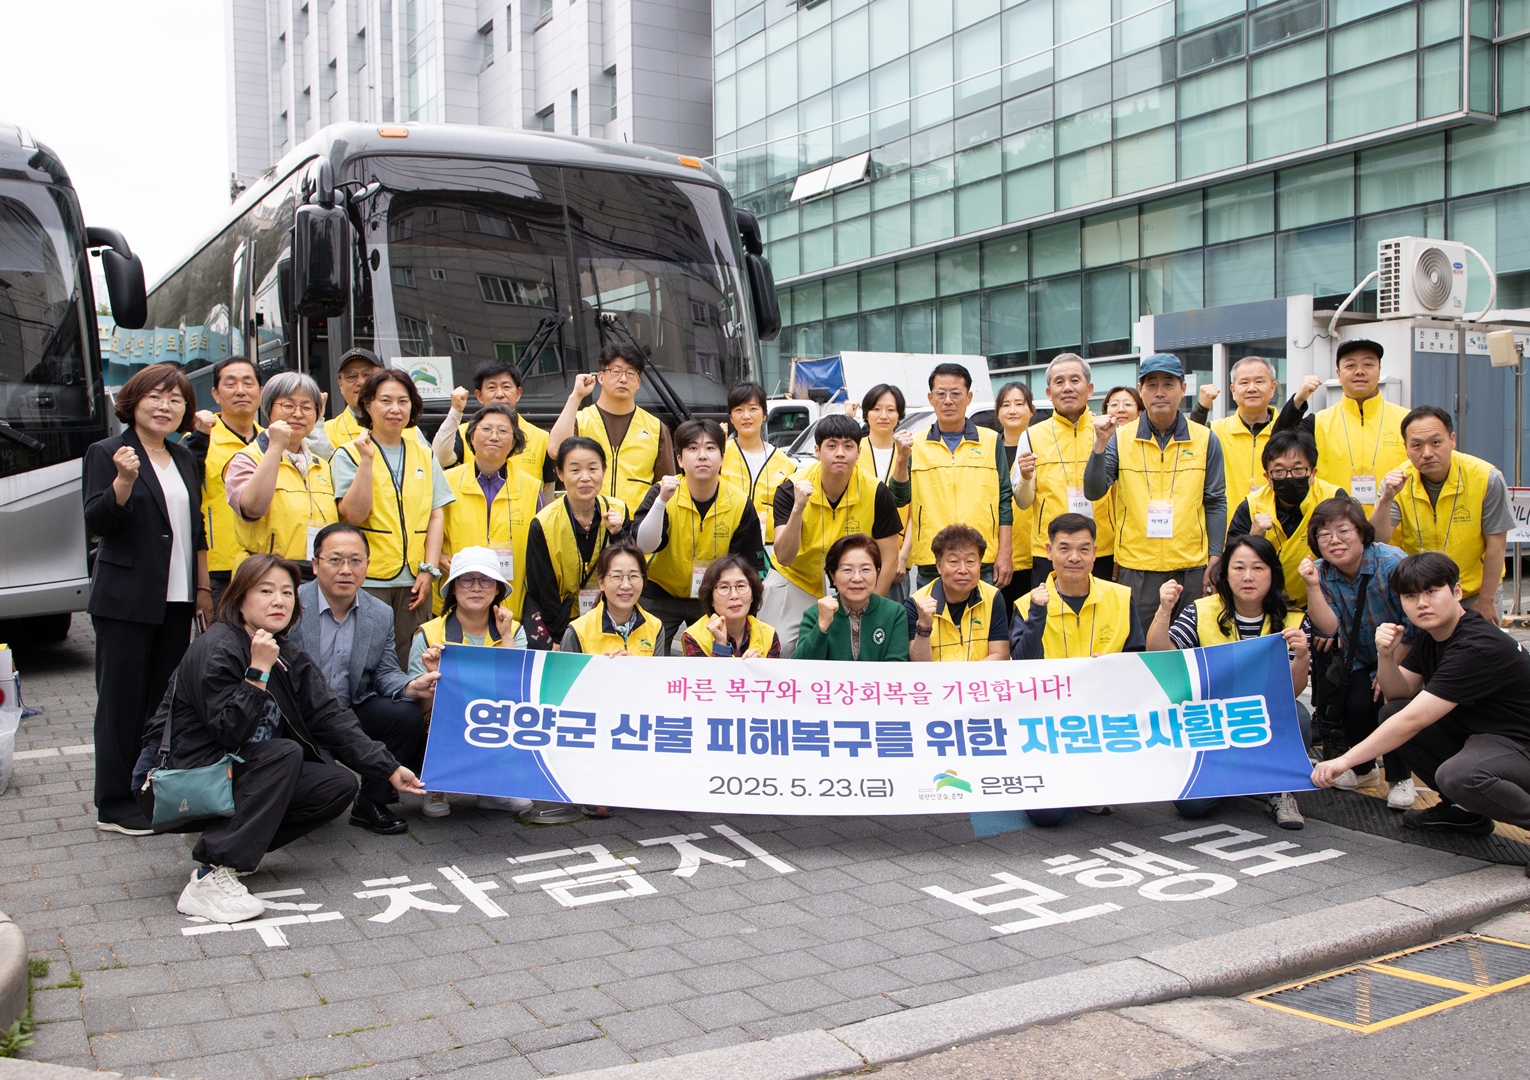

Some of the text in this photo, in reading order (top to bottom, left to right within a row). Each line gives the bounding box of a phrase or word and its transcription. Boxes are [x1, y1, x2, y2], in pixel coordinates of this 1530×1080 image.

[666, 674, 1073, 706] 빠른 복구와 일상회복을 기원합니다!
[469, 699, 1270, 758] 영양군 산불 피해복구를 위한 자원봉사활동
[708, 776, 895, 799] 2025. 5. 23.(금)
[980, 775, 1045, 795] 은평구
[180, 824, 797, 947] 주차금지
[920, 823, 1347, 934] 보행로
